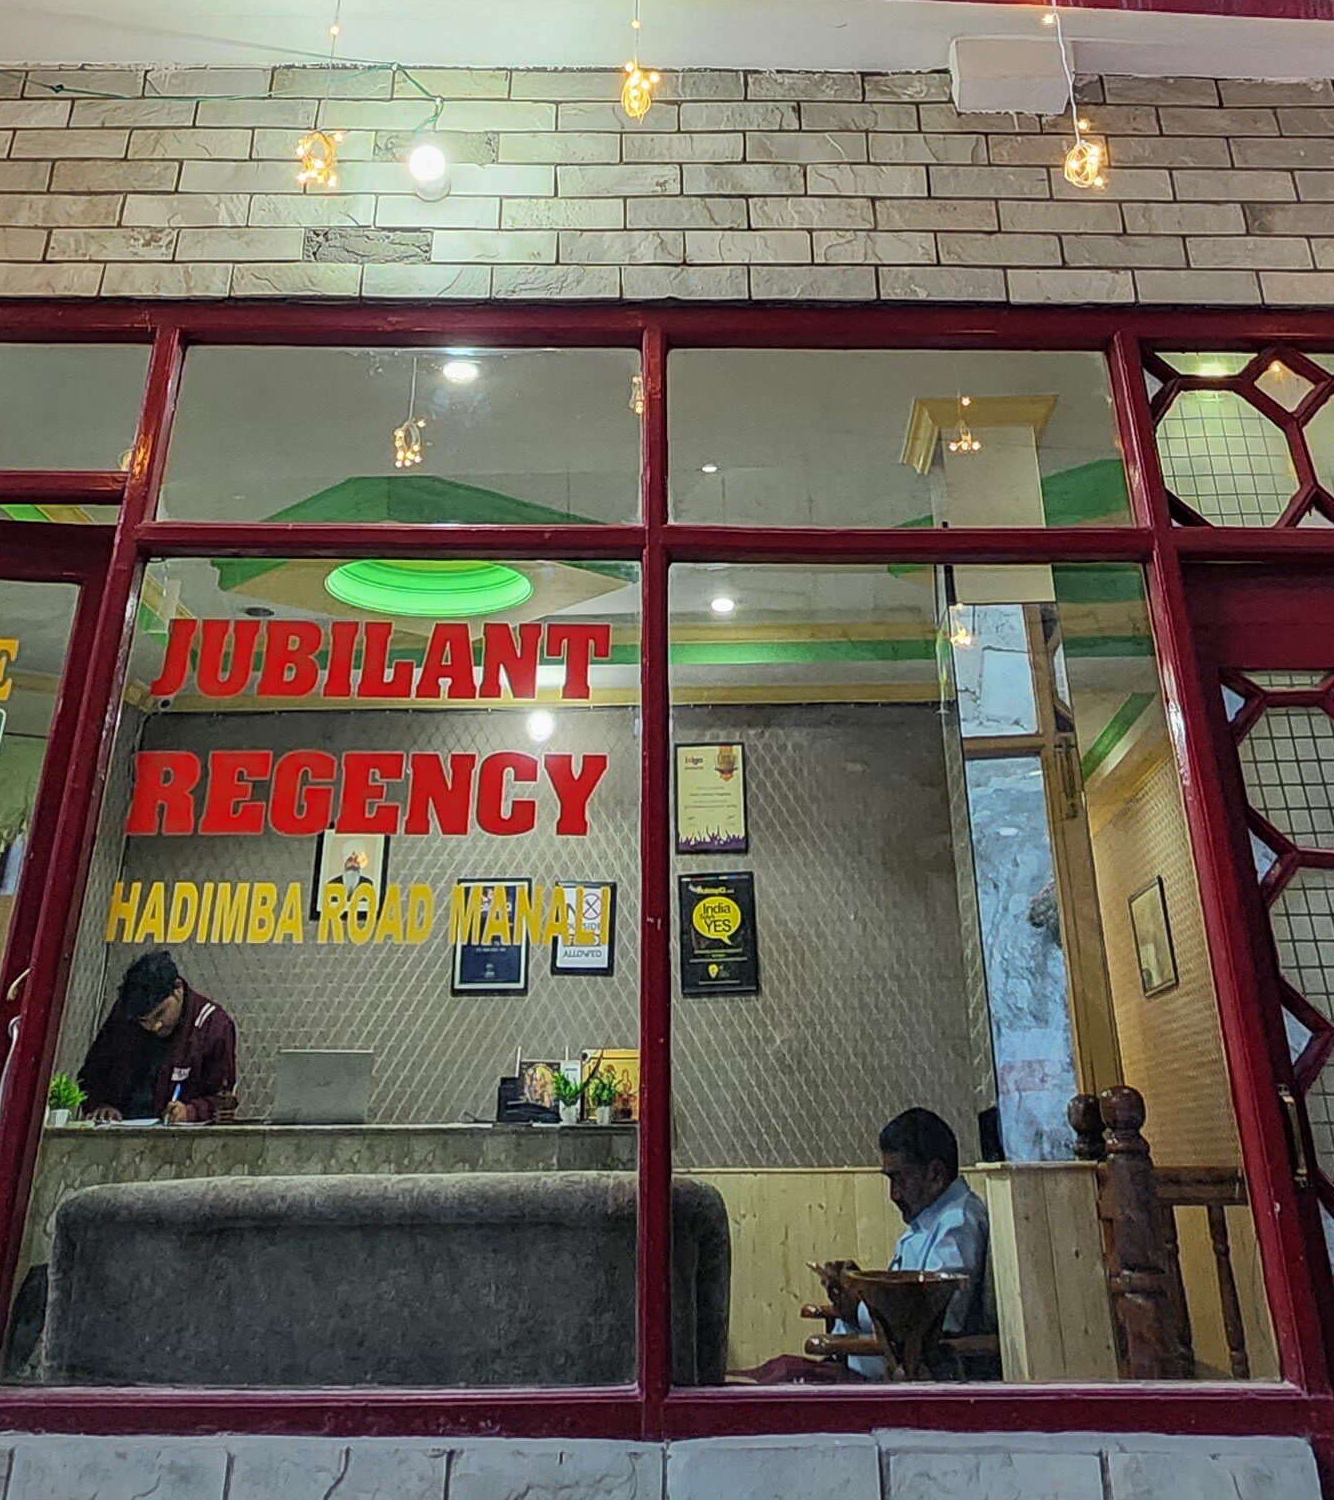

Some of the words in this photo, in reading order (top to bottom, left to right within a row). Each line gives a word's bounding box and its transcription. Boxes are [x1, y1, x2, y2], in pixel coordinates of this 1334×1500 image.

[149, 618, 611, 700] JUBILANT
[124, 750, 609, 837] REGENCY
[104, 882, 303, 943] HADIMBA
[318, 882, 434, 943] ROAD
[449, 884, 611, 946] MANALI
[703, 902, 731, 915] India
[704, 918, 732, 933] YES
[563, 949, 602, 958] ALLOWED
